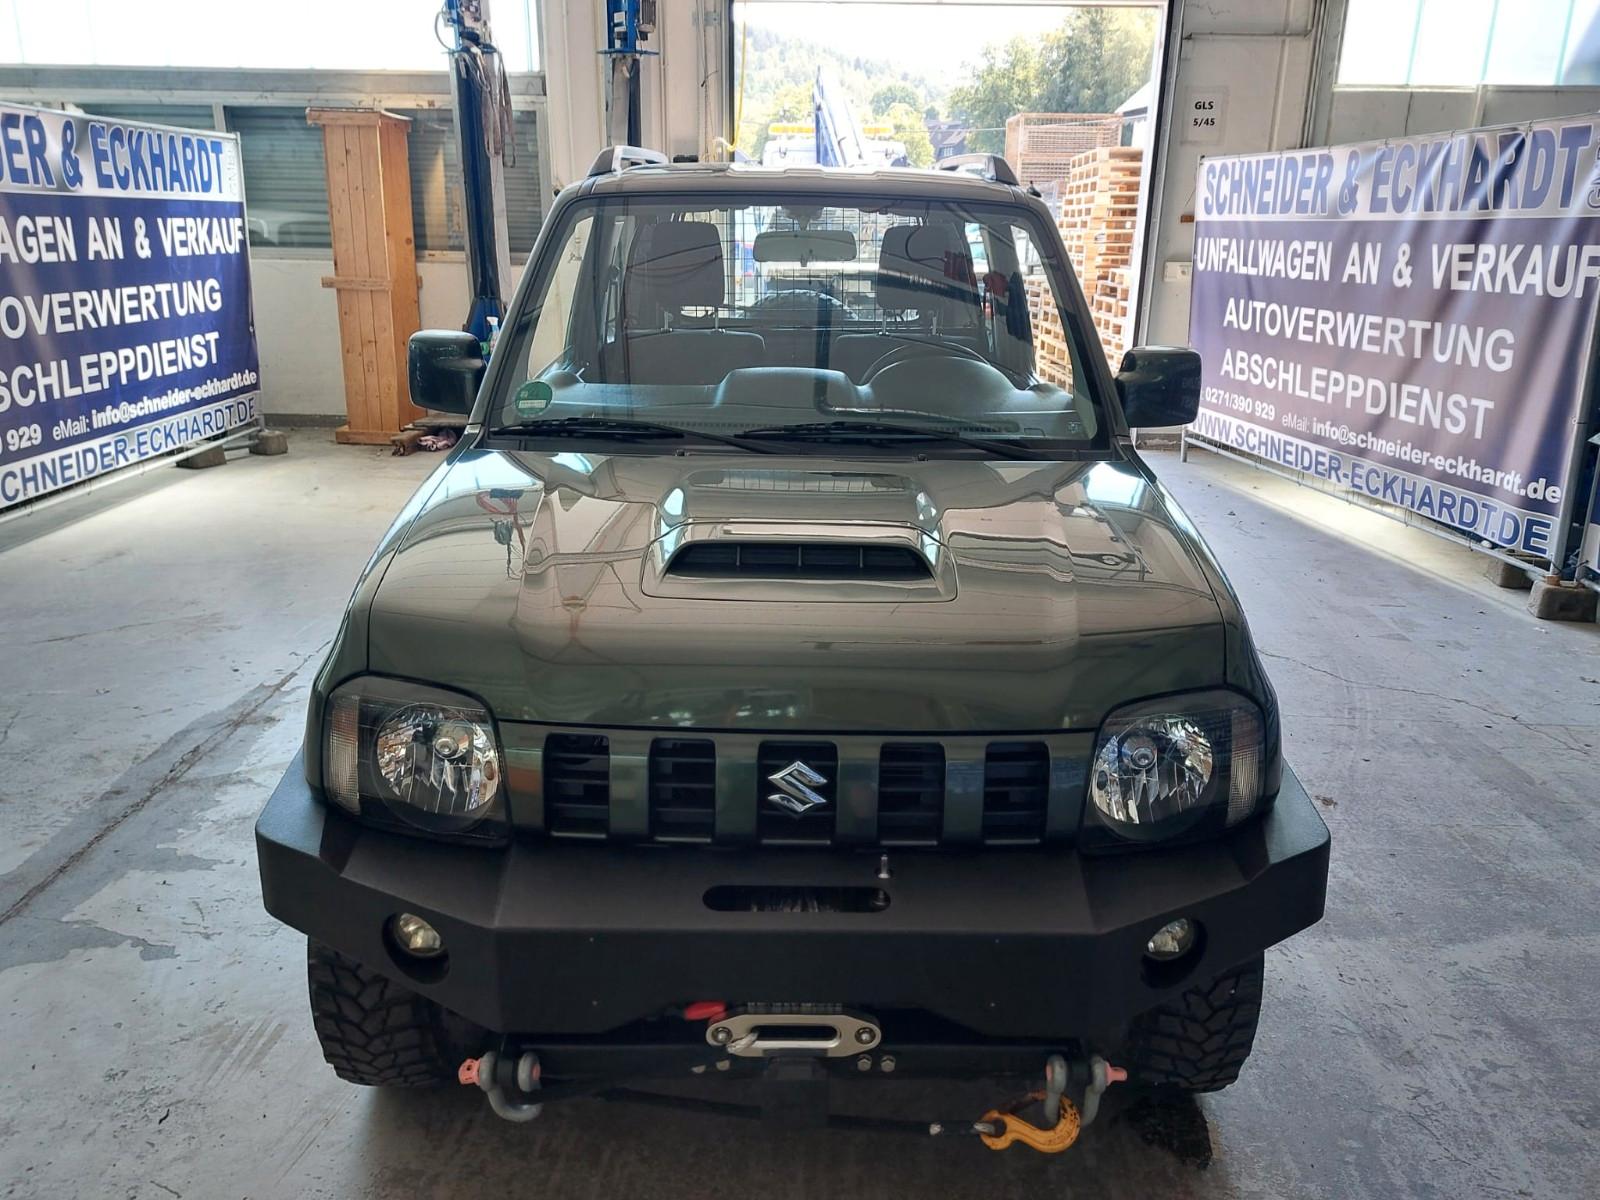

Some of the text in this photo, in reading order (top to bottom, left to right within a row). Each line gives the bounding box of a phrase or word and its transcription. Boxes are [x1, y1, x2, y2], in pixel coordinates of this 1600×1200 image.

[1193, 117, 1216, 127] 5/45
[1194, 101, 1214, 110] GLS
[0, 113, 223, 193] ER & ECKHARDT
[1203, 153, 1333, 216] SCHNEIDER
[1338, 150, 1361, 215] &
[1369, 124, 1592, 214] ECKHARDT
[88, 216, 124, 260] AN
[135, 216, 152, 259] &
[158, 217, 244, 257] VERKAUF
[1197, 237, 1600, 299] UNFALLWAGEN AN & VERKAUF
[0, 277, 222, 340] OVERWERTUNG
[1223, 297, 1515, 373] AUTOVERWERTUNG
[6, 423, 42, 452] 929
[53, 415, 90, 441] eMail:
[92, 369, 258, 430] info@schneider-eckhardt.de
[1220, 348, 1495, 440] ABSCHLEPPDIENST
[0, 396, 256, 502] CHNEIDER-ECKHARDT.DE
[1205, 386, 1563, 504] 0271/390 929 eMail: info@schneider-eckhardt.de
